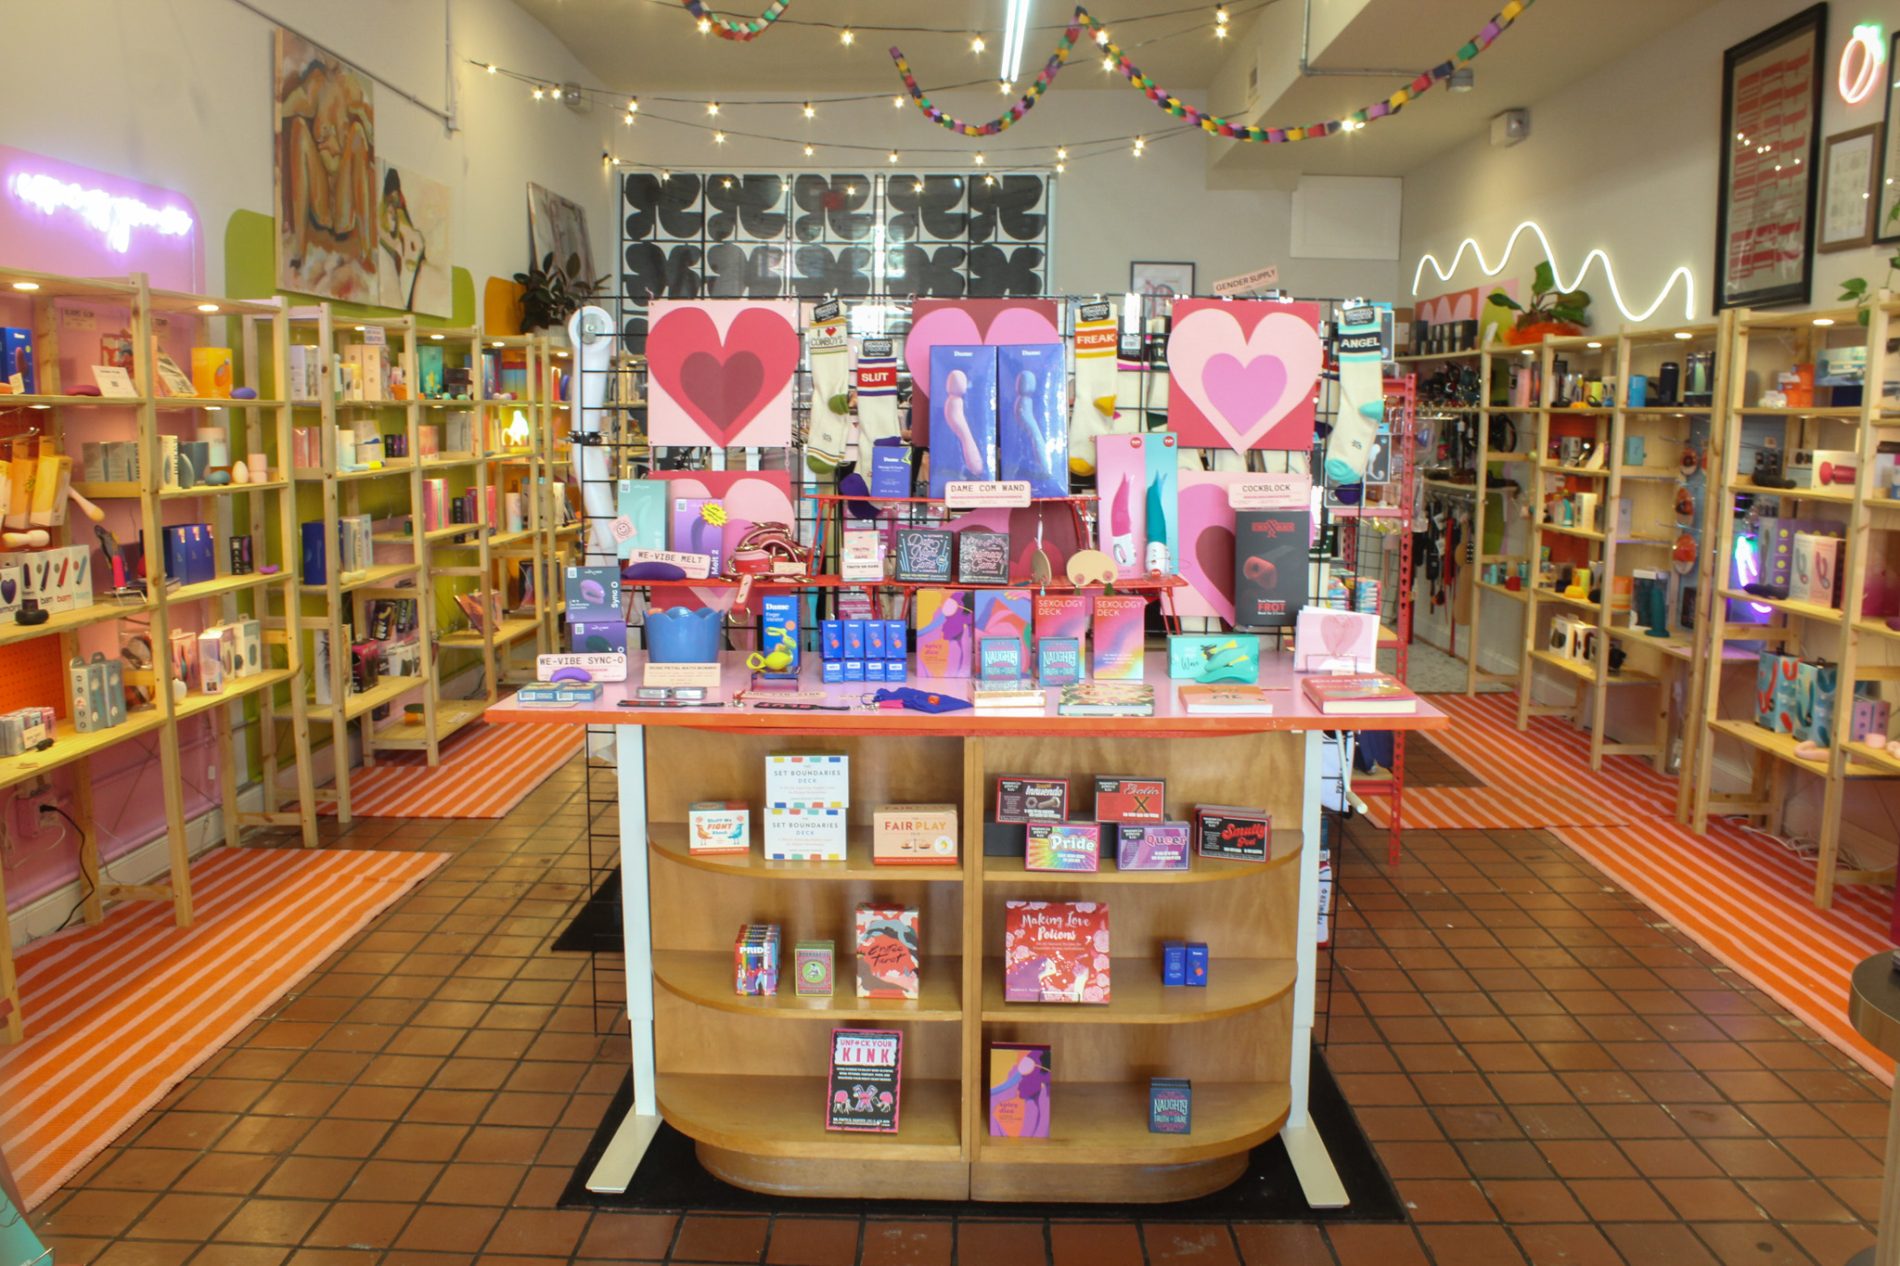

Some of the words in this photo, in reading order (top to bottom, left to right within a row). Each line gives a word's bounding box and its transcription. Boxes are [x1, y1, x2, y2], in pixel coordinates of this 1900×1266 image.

[1076, 333, 1116, 344] FREAK
[1341, 337, 1380, 348] ANGEL
[861, 372, 889, 382] SLUT
[950, 484, 974, 492] DAME
[979, 484, 997, 492] COM
[1002, 484, 1024, 492] WAND
[1242, 484, 1290, 492] COCKBLOCK
[638, 551, 675, 561] WE-VIBE
[681, 556, 703, 564] MELT
[711, 556, 719, 575] Melt
[611, 589, 620, 608] Sync
[1038, 600, 1083, 608] SEXOLOGY
[765, 603, 789, 611] Dame
[1096, 601, 1141, 609] SEXOLOGY
[1258, 603, 1286, 611] FROT
[540, 657, 582, 665] WE-VIBE
[588, 656, 624, 664] SYNC-O
[985, 650, 1018, 667] NAUGHTY
[1043, 650, 1076, 667] NAUGHTY
[1025, 785, 1063, 796] Innuendo
[707, 823, 733, 831] FIGHT
[884, 821, 912, 830] FAIR
[915, 821, 946, 830] PLAY
[1051, 835, 1095, 851] Pride
[1145, 834, 1187, 848] Queer
[1021, 912, 1063, 929] Making
[1066, 910, 1090, 928] Love
[1037, 925, 1076, 941] Potions
[739, 946, 770, 954] PRIDE
[842, 1047, 889, 1063] KINK
[1154, 1098, 1188, 1116] NAUGHTY
